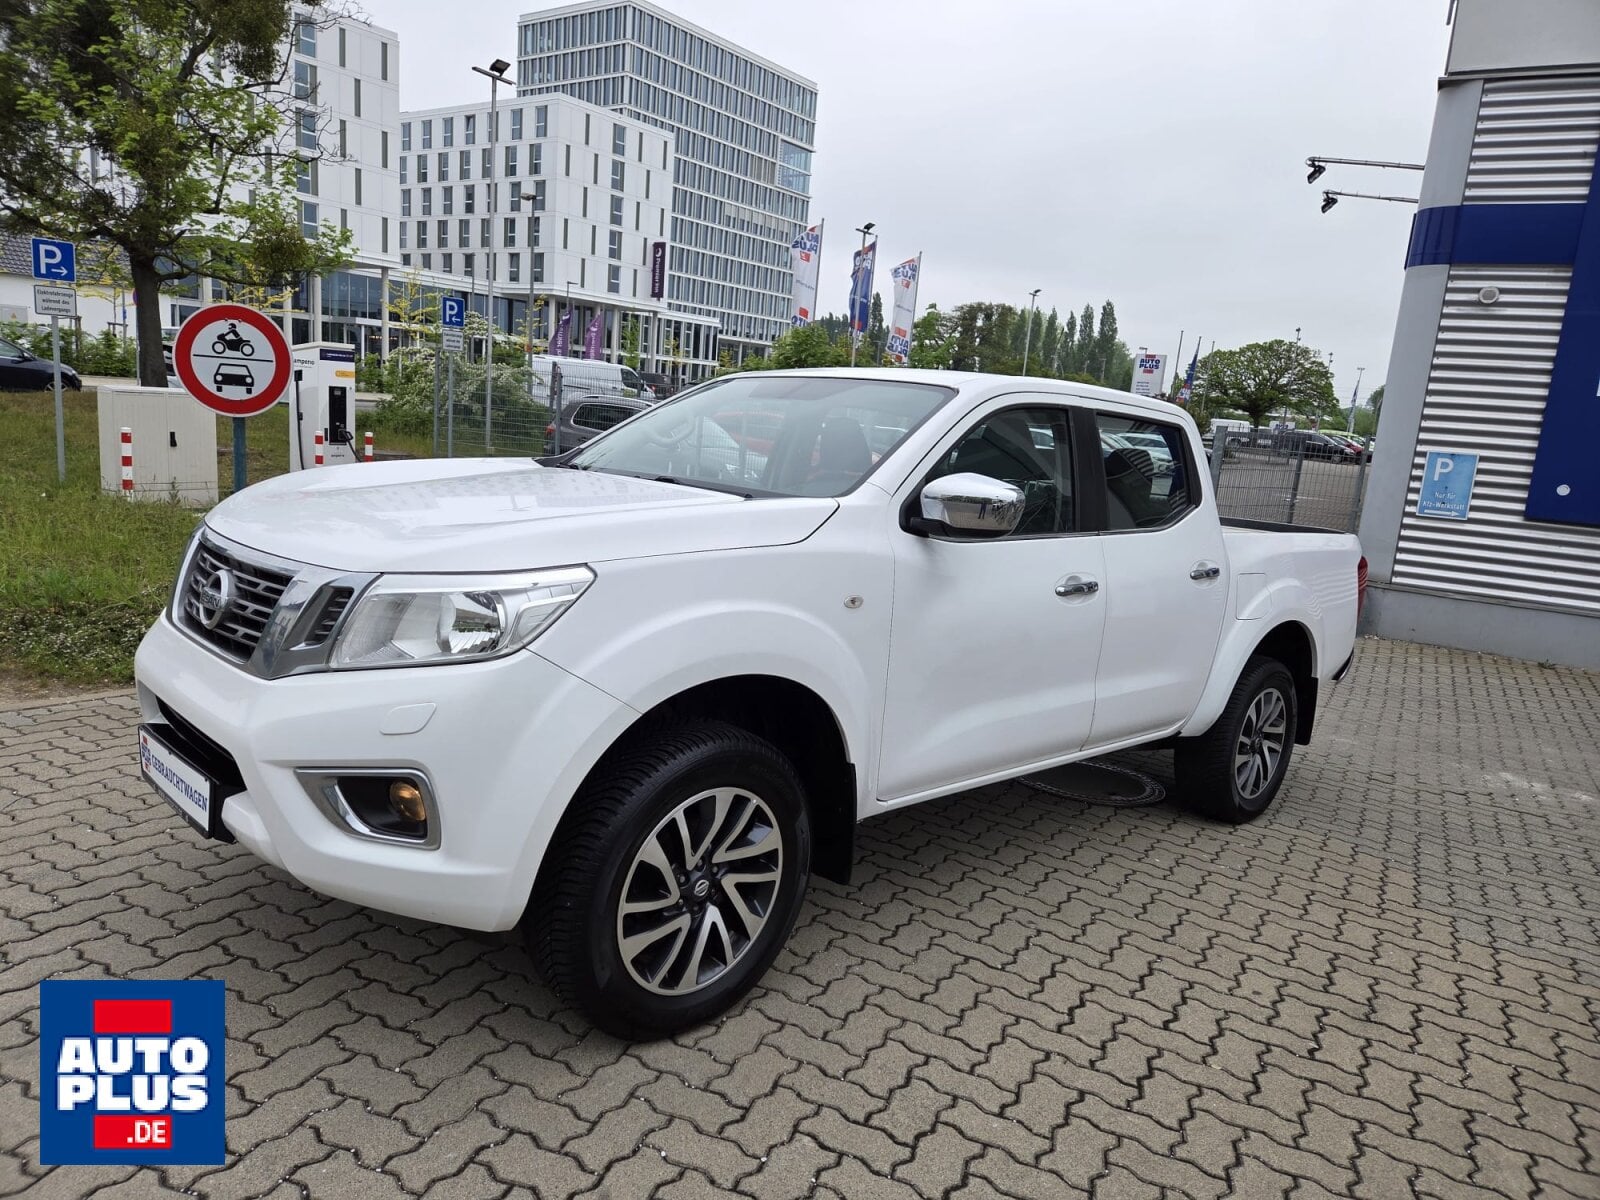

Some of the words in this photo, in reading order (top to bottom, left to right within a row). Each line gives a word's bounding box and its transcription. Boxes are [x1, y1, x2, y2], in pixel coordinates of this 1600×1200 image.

[39, 244, 62, 274] P
[446, 300, 458, 322] P
[1434, 457, 1454, 481] P
[1422, 500, 1465, 510] Kfz-Werkstatt
[1447, 491, 1456, 499] für
[151, 754, 208, 812] GEBRAUCHTWAGEN
